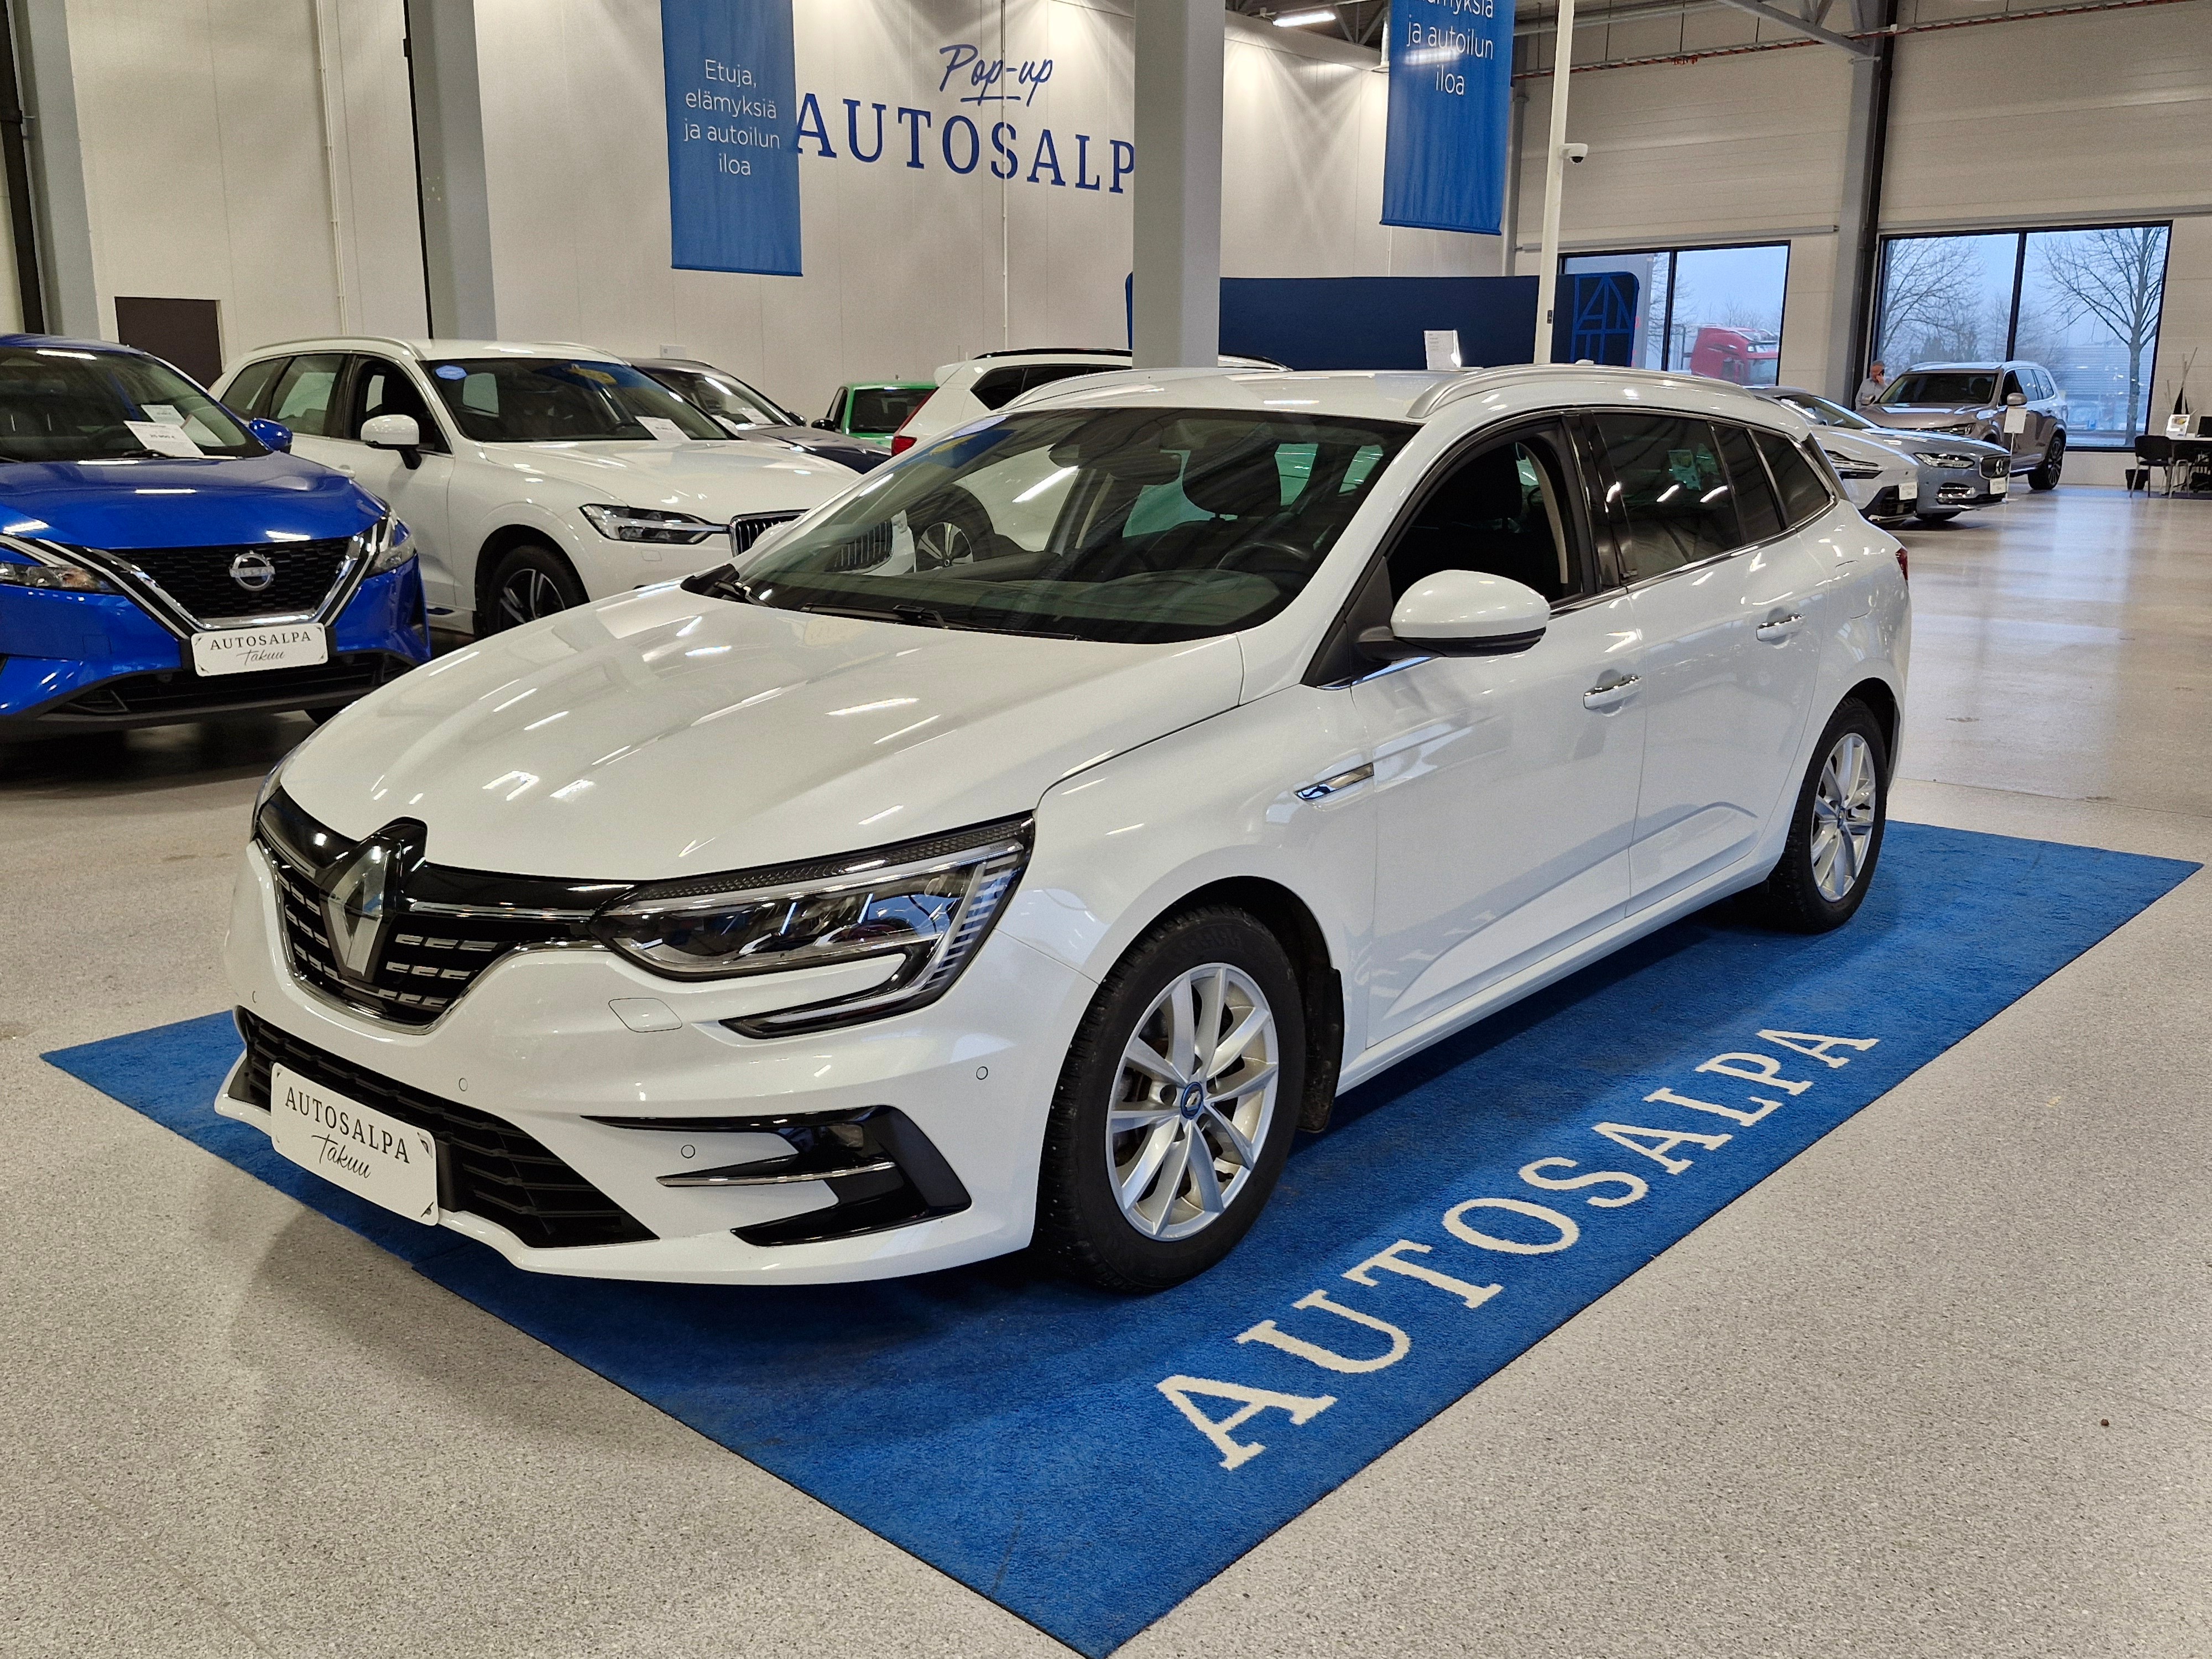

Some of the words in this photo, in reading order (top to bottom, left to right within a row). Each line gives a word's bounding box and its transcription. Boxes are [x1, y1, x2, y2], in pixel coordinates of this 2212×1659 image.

[1406, 14, 1421, 47] ja
[1428, 25, 1493, 60] autoilun
[705, 59, 757, 88] Etuja,
[940, 44, 1053, 107] Pop-up
[1436, 64, 1465, 96] iloa
[686, 88, 777, 119] elämyksiä
[684, 118, 701, 142] ja
[707, 125, 781, 149] autoilun
[794, 92, 1134, 194] AUTOSALP
[719, 153, 751, 176] iloa
[231, 567, 275, 577] NISSAN
[210, 630, 311, 651] AUTOSALPA
[236, 649, 285, 666] Takuu
[285, 1086, 410, 1164] AUTOSALPA
[311, 1133, 372, 1179] Takuu
[1155, 1029, 1880, 1472] AUTOSALPA
